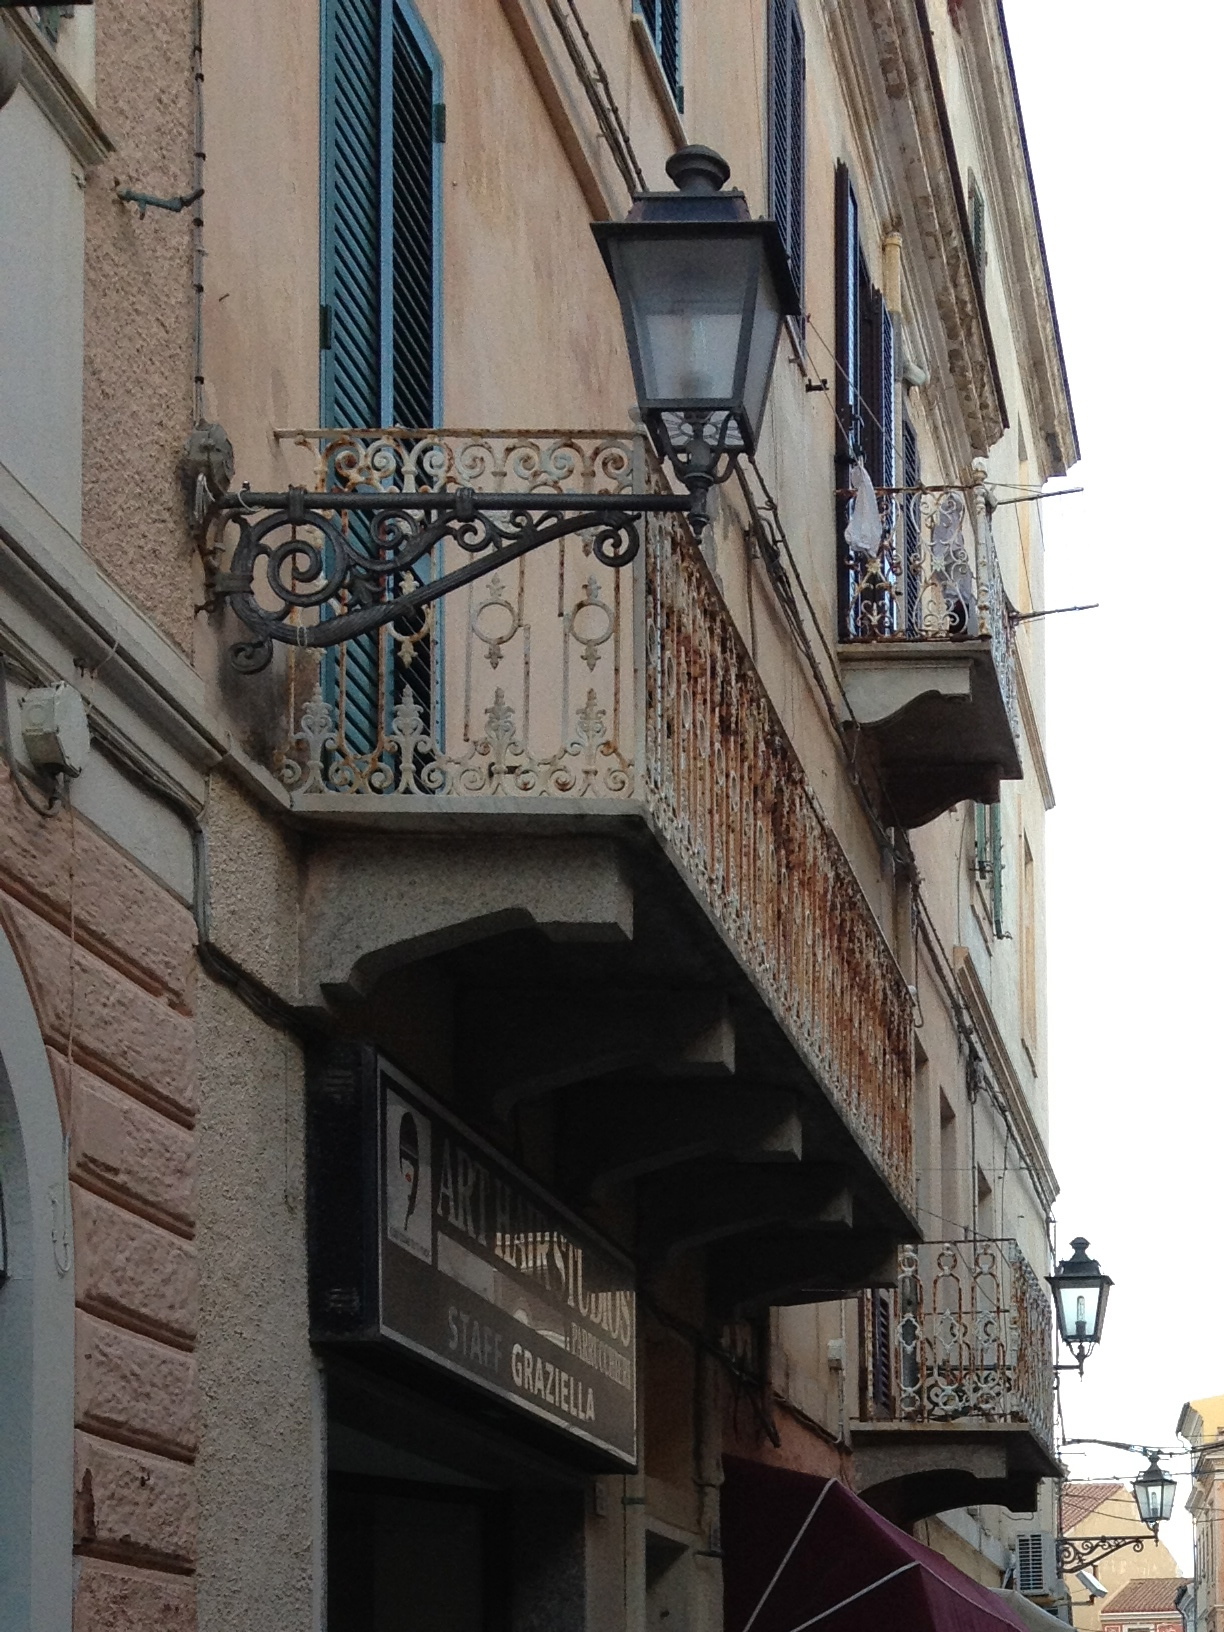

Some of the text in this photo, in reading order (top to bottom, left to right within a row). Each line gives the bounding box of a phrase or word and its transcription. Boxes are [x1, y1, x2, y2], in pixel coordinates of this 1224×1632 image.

[437, 1138, 631, 1347] ART HAIR STUDIOS
[448, 1306, 502, 1374] STAFF
[511, 1343, 596, 1422] GRAZIELLA
